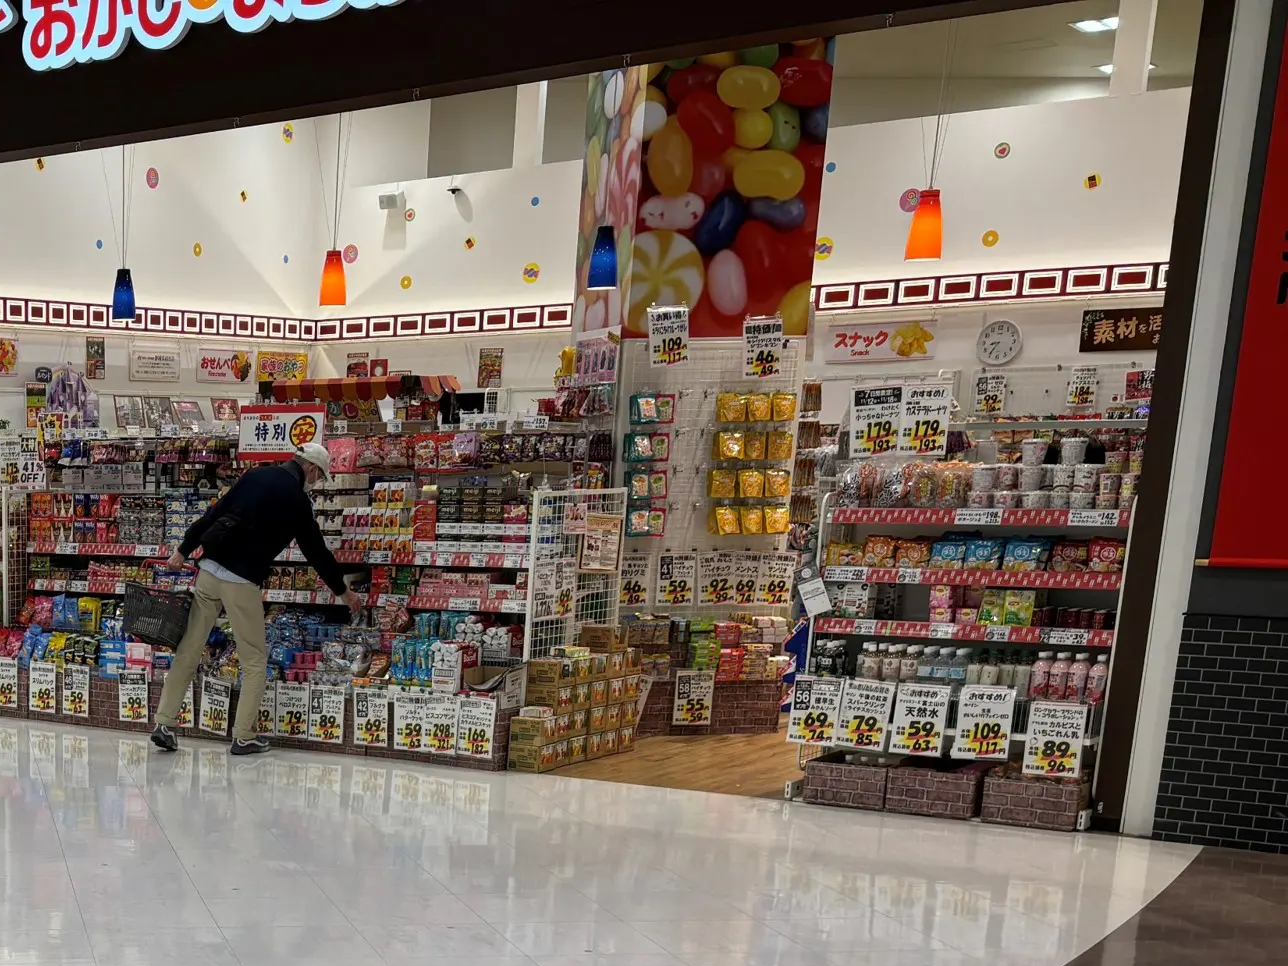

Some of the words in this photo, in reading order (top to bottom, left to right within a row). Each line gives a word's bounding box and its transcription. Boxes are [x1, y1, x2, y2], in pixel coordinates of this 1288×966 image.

[834, 330, 889, 348] スナック
[910, 390, 944, 398] おすすめ!
[866, 420, 899, 440] 179円
[913, 420, 946, 439] 179円
[22, 461, 43, 472] 41%
[735, 566, 759, 574] メントス
[668, 580, 691, 593] 59円
[768, 580, 789, 592] 69円
[207, 697, 225, 708] コロロ
[795, 690, 810, 702] 56
[859, 693, 888, 702] 午後の紅茶
[968, 692, 1007, 701] おすすめ!
[847, 699, 885, 709] スパークリング
[905, 706, 939, 718] 天然水
[319, 714, 341, 729] 89円
[364, 718, 386, 732] 69円
[803, 712, 834, 729] 69円
[853, 715, 883, 733] 79円
[1049, 722, 1081, 730] カルピスと
[467, 727, 490, 743] 169円
[808, 730, 832, 742] 74円
[908, 721, 940, 738] 59円
[973, 723, 1007, 740] 109円
[1033, 729, 1080, 739] いちごれん乳
[855, 733, 880, 747] 85円
[912, 739, 938, 753] 63円
[978, 742, 1006, 755] 117円
[1042, 740, 1077, 759] 89円
[1047, 760, 1075, 774] 96円
